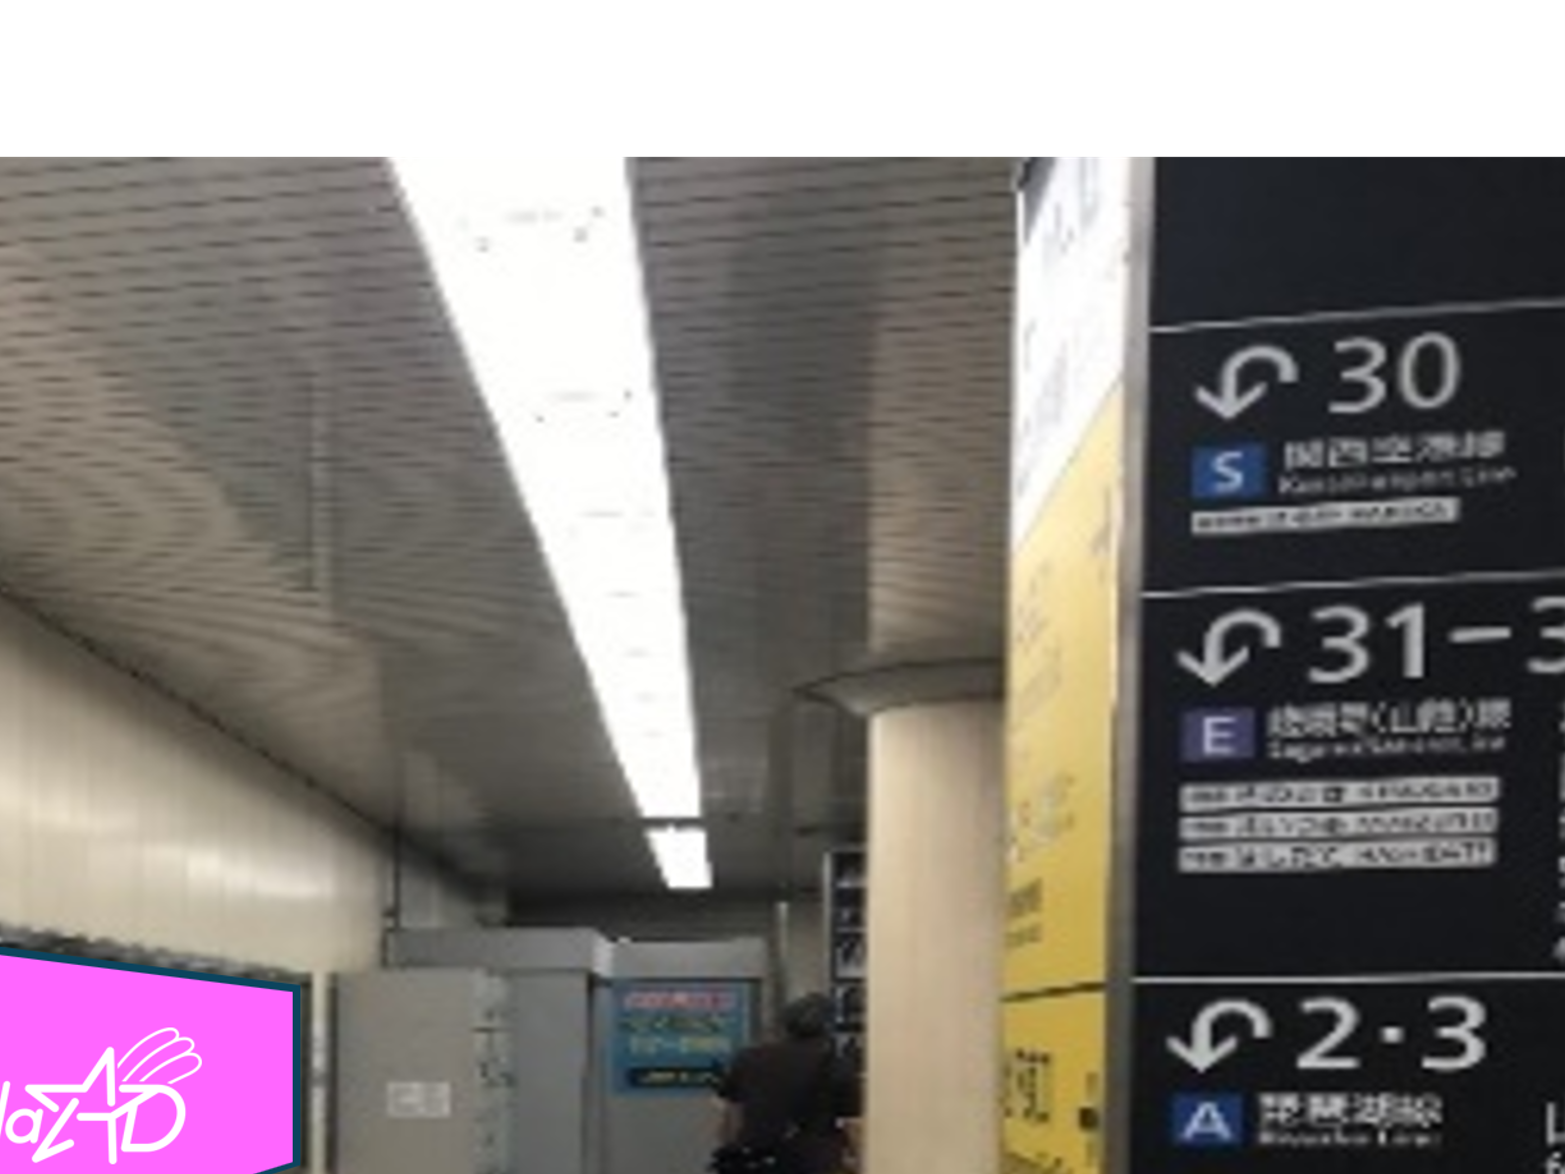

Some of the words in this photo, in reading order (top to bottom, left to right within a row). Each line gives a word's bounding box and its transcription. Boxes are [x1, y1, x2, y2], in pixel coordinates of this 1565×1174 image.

[1329, 332, 1461, 414] 30
[1211, 450, 1244, 493] S
[1202, 715, 1237, 755] E
[1183, 1102, 1232, 1141] A
